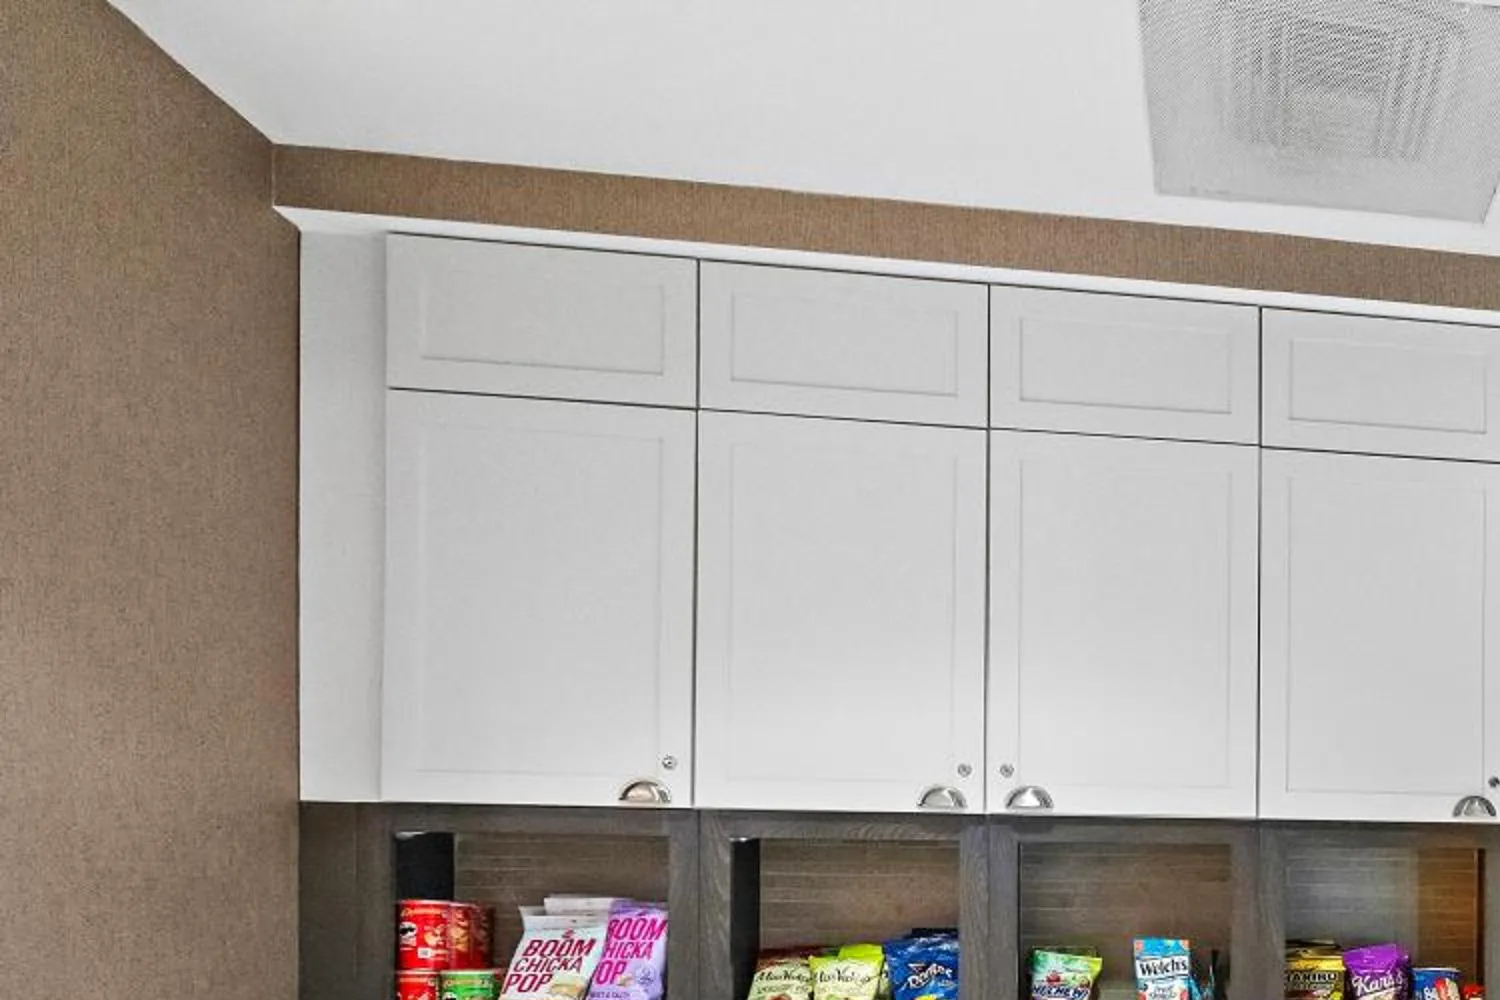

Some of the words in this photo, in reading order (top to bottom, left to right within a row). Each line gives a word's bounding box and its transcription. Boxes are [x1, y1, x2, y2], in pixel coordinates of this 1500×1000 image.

[522, 938, 597, 958] BOOM
[602, 941, 654, 960] HICKA
[513, 956, 584, 973] CHICKA
[594, 960, 628, 986] OP
[1139, 959, 1188, 976] Welch's
[502, 973, 554, 995] POP
